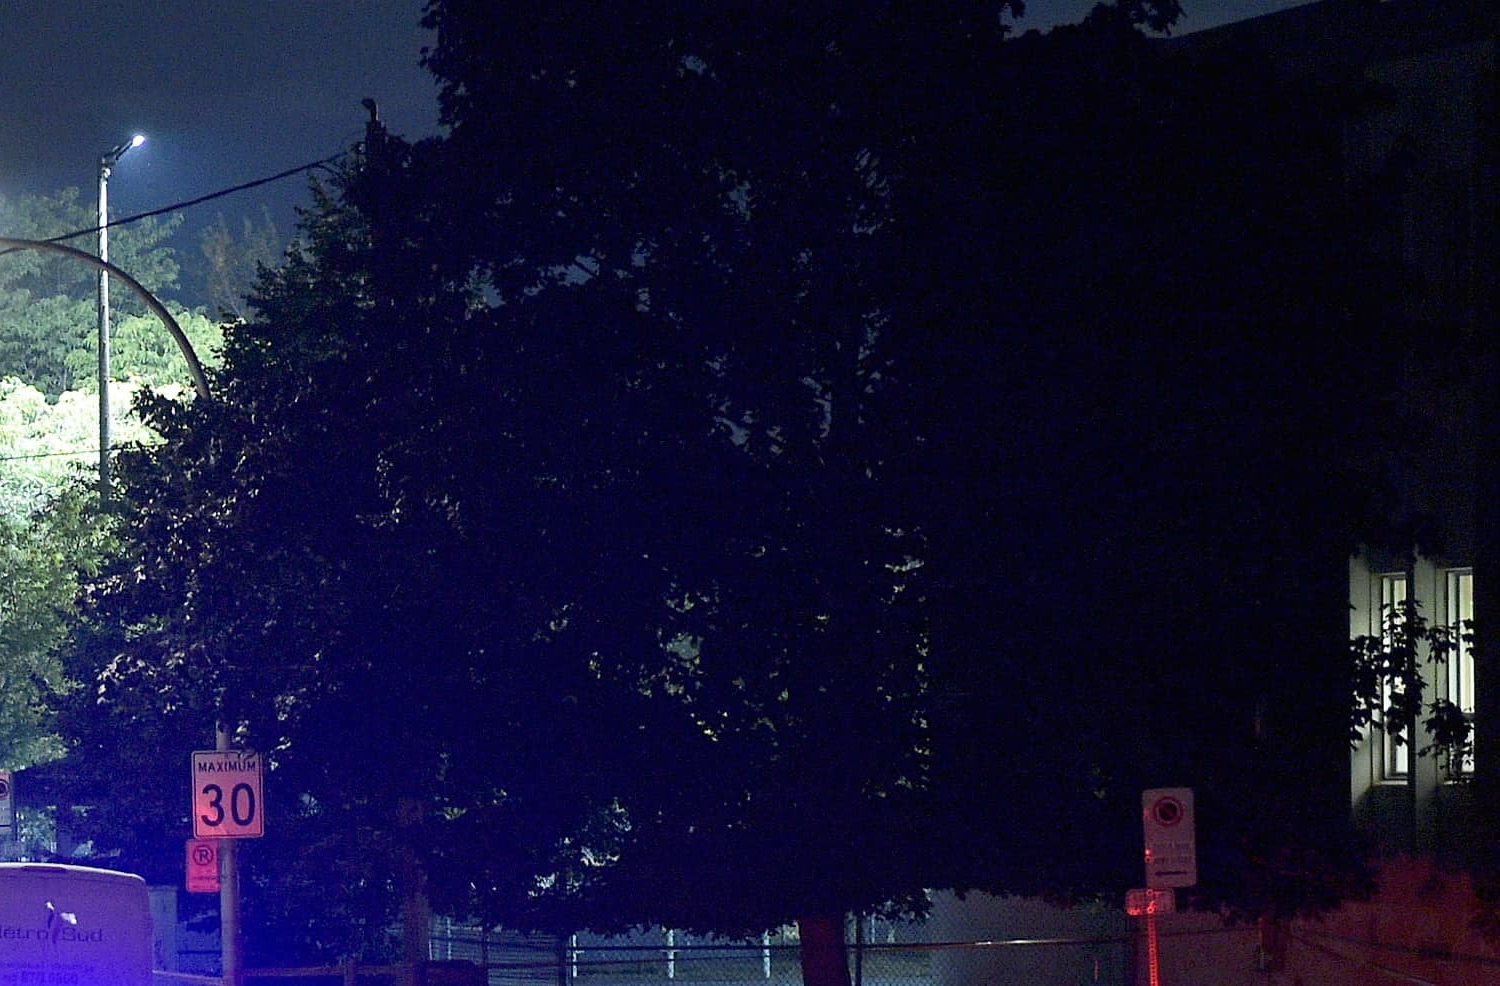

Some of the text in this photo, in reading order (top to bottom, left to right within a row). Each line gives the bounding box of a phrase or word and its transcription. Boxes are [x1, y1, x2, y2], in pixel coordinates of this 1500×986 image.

[198, 762, 256, 772] MAXIMUM
[201, 783, 255, 826] 30
[62, 928, 102, 942] Sud
